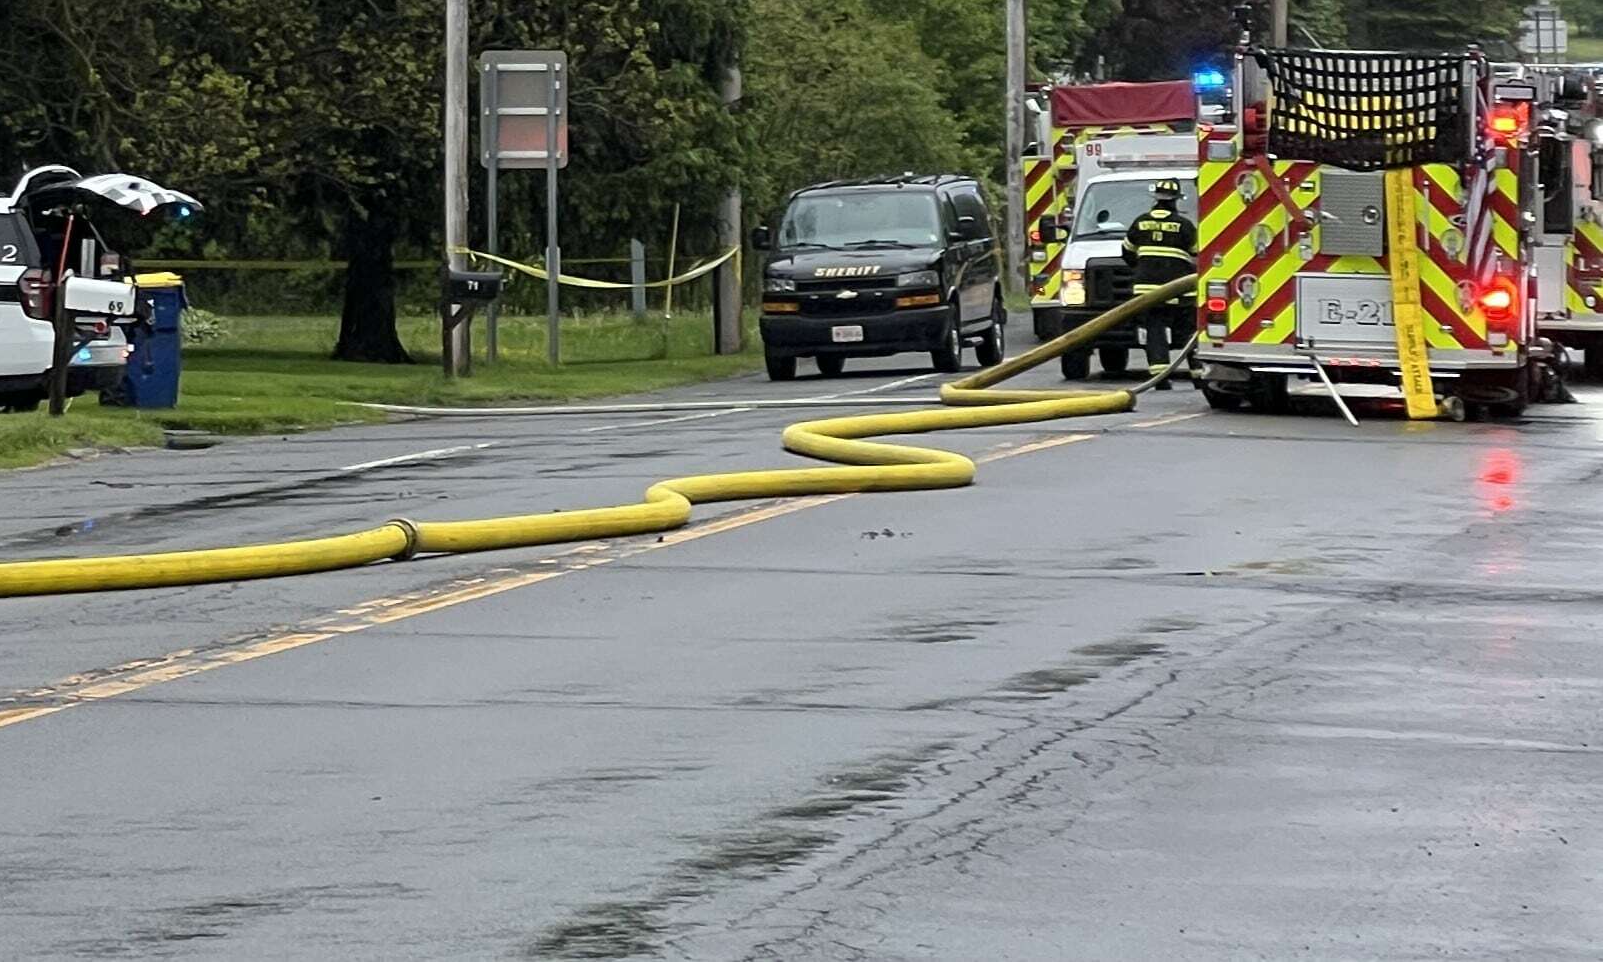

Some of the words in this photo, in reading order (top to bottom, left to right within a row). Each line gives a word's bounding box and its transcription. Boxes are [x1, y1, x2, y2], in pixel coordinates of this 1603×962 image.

[1, 244, 17, 262] 2
[814, 265, 881, 277] SHERIFF
[467, 280, 479, 291] 71
[108, 300, 124, 313] 69
[1319, 298, 1395, 326] E-21
